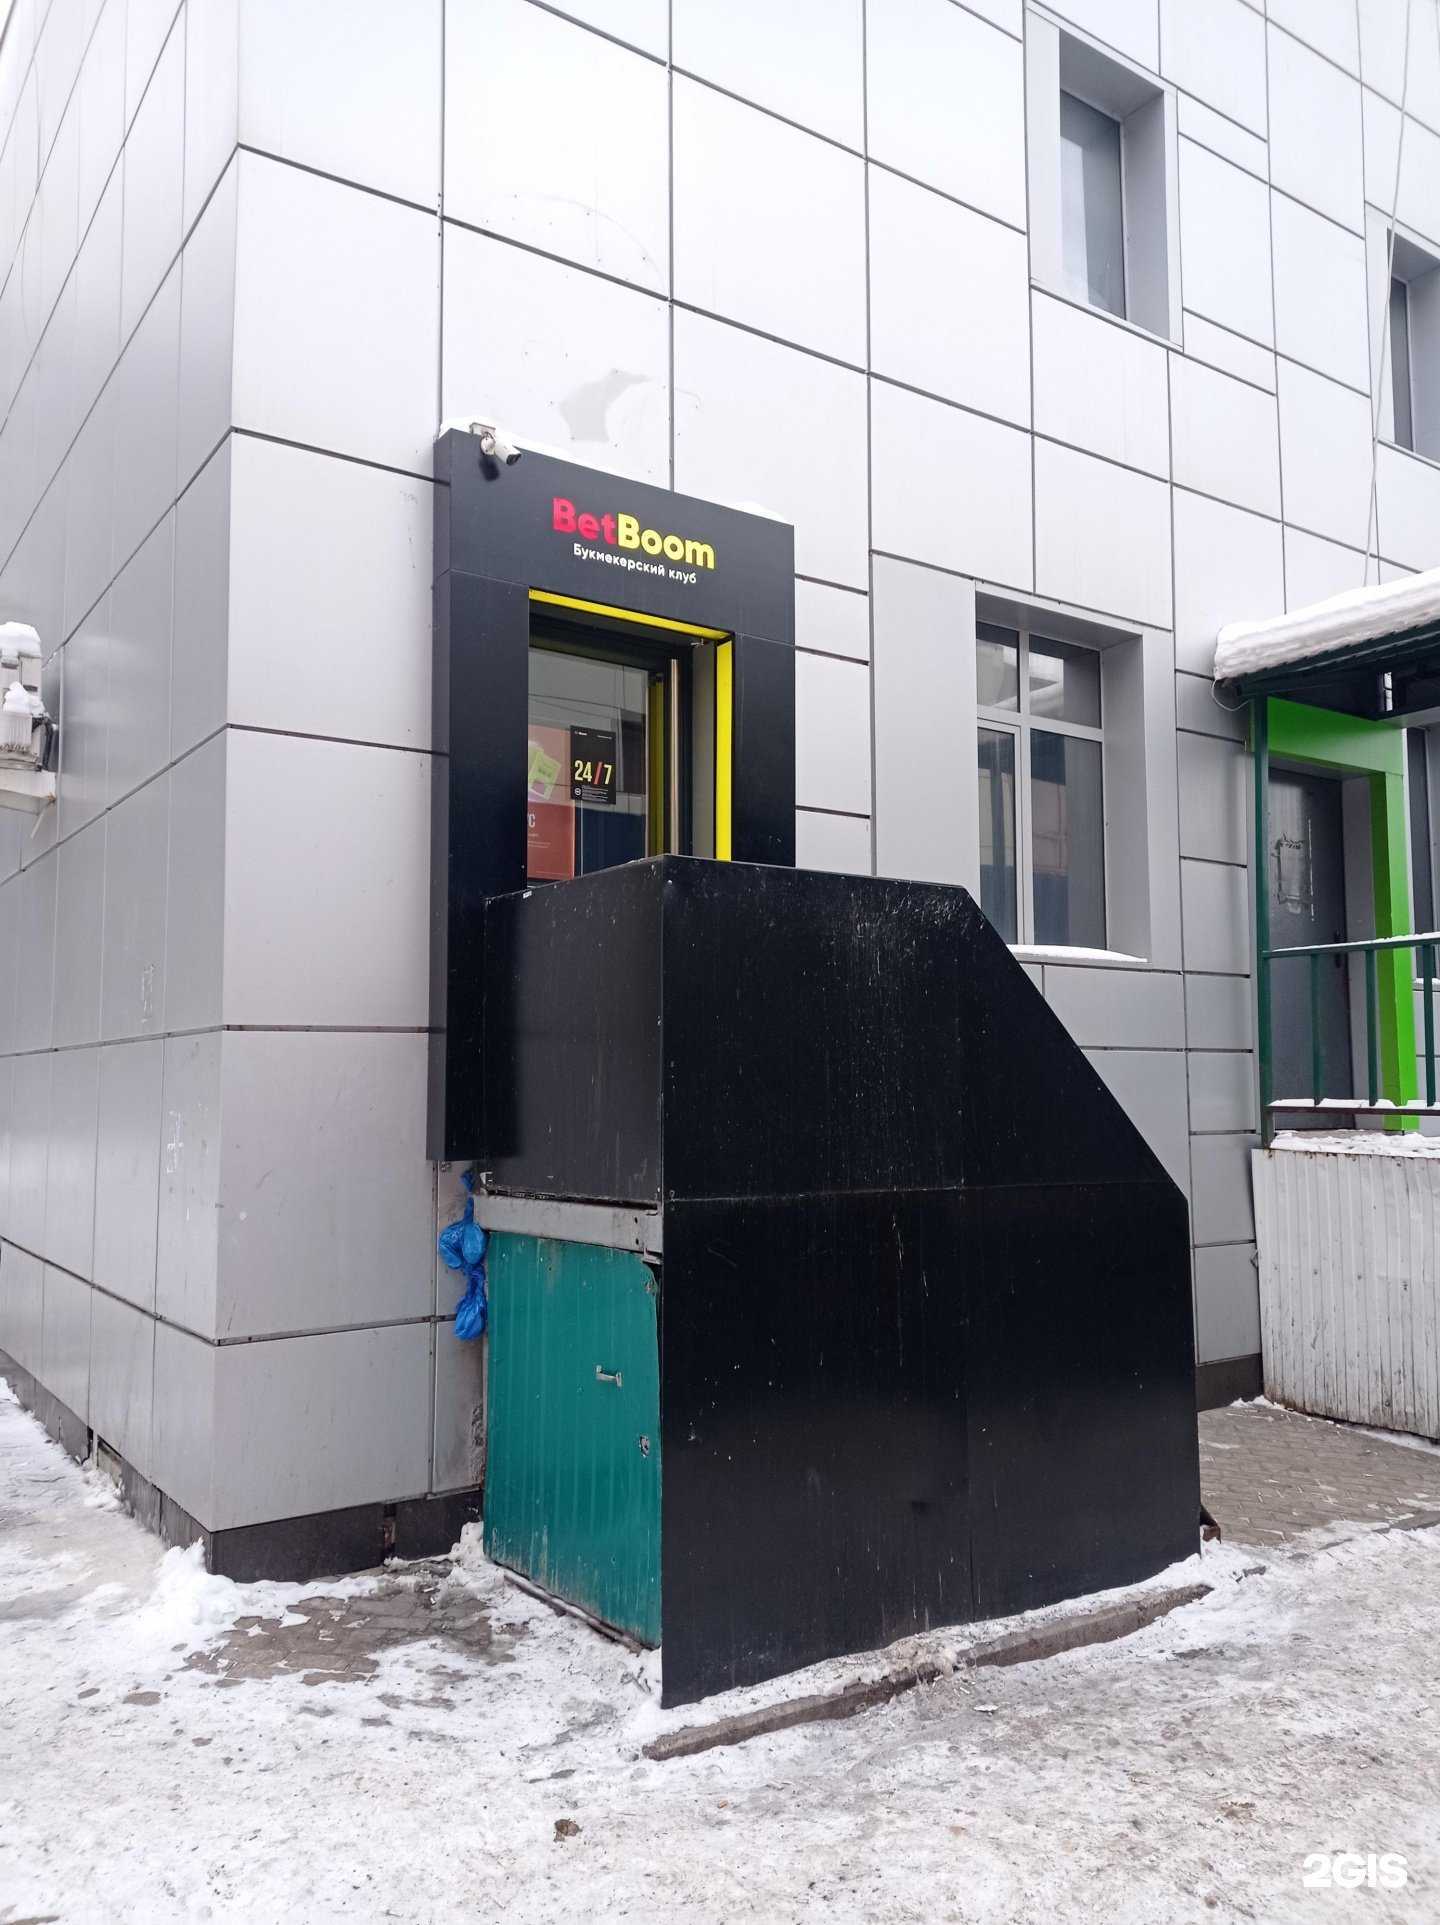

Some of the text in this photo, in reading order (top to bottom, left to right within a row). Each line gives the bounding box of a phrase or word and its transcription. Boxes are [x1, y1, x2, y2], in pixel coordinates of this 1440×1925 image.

[552, 497, 715, 569] BetBoom
[573, 543, 697, 584] Букмекерский клуб
[574, 760, 612, 785] 24/7
